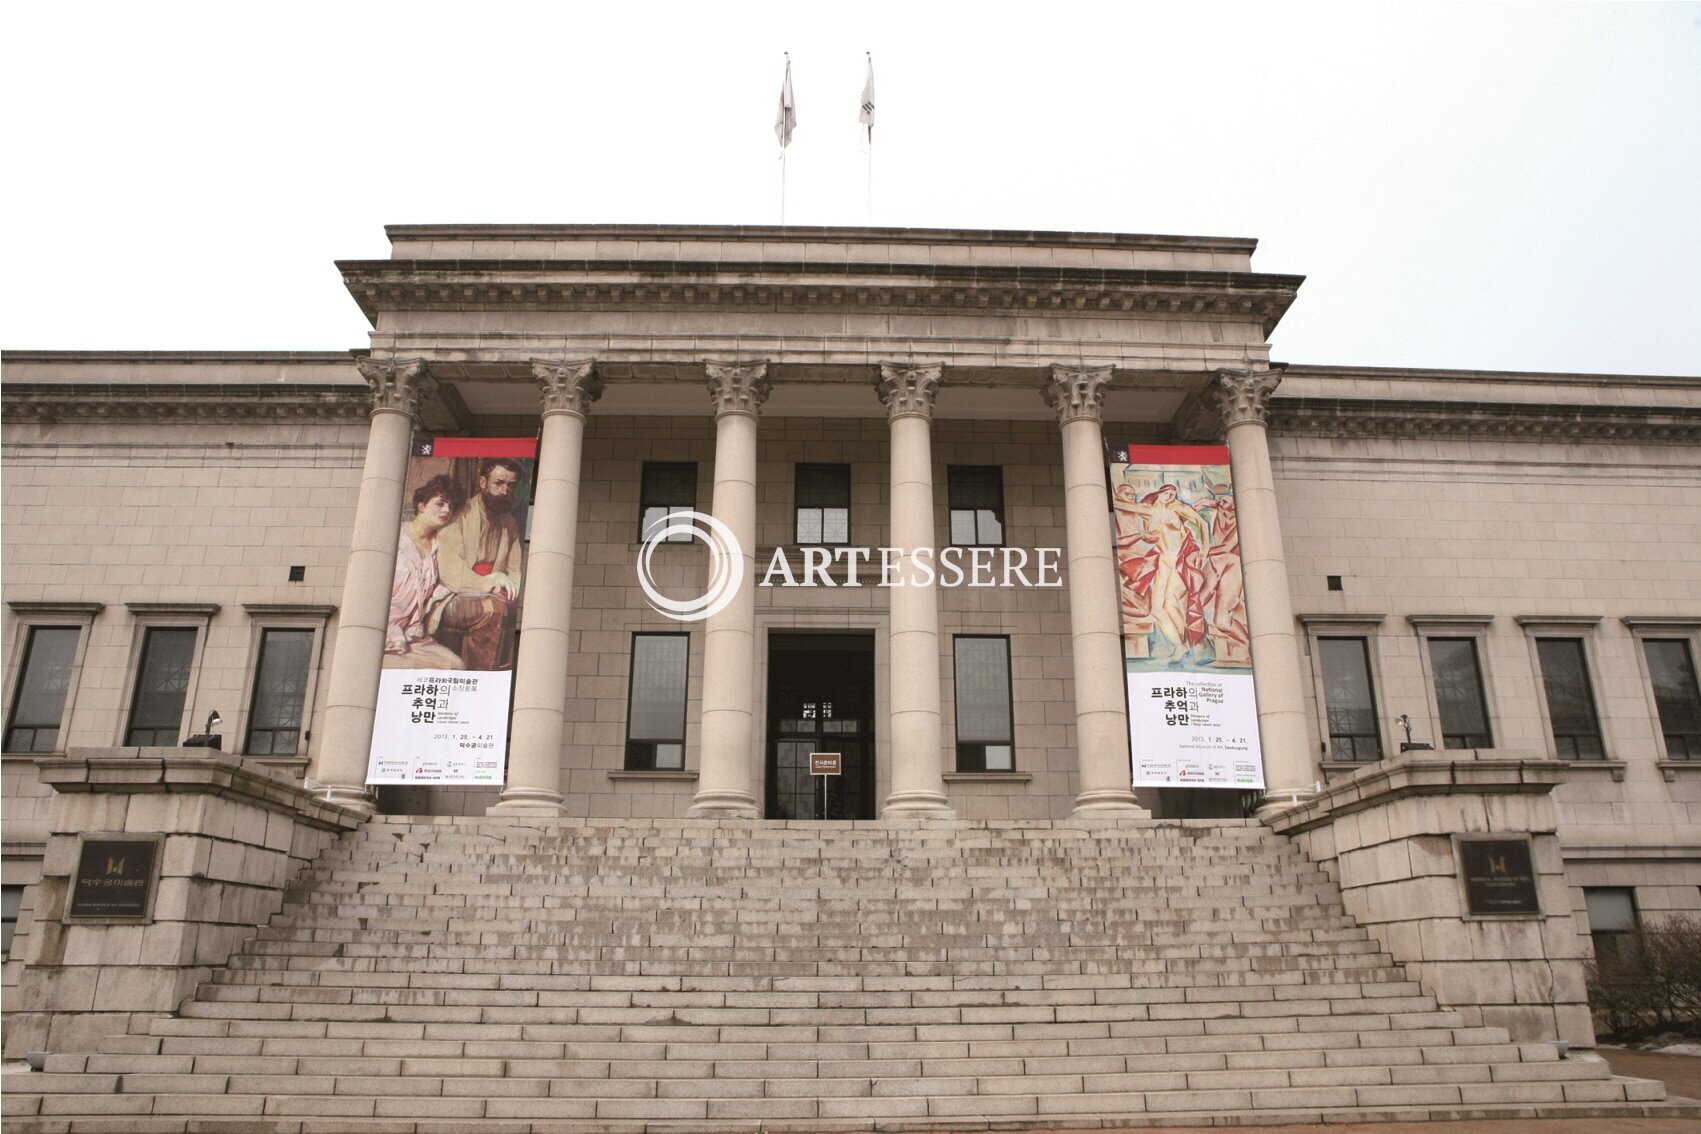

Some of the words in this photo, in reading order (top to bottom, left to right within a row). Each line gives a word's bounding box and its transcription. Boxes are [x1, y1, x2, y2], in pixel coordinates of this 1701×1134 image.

[401, 684, 450, 697] 프라하의
[1151, 687, 1198, 699] 프라하의
[412, 697, 448, 710] 추억과
[1164, 700, 1199, 713] 추억과
[411, 711, 436, 724] 낭만
[1165, 714, 1189, 726] 낭만
